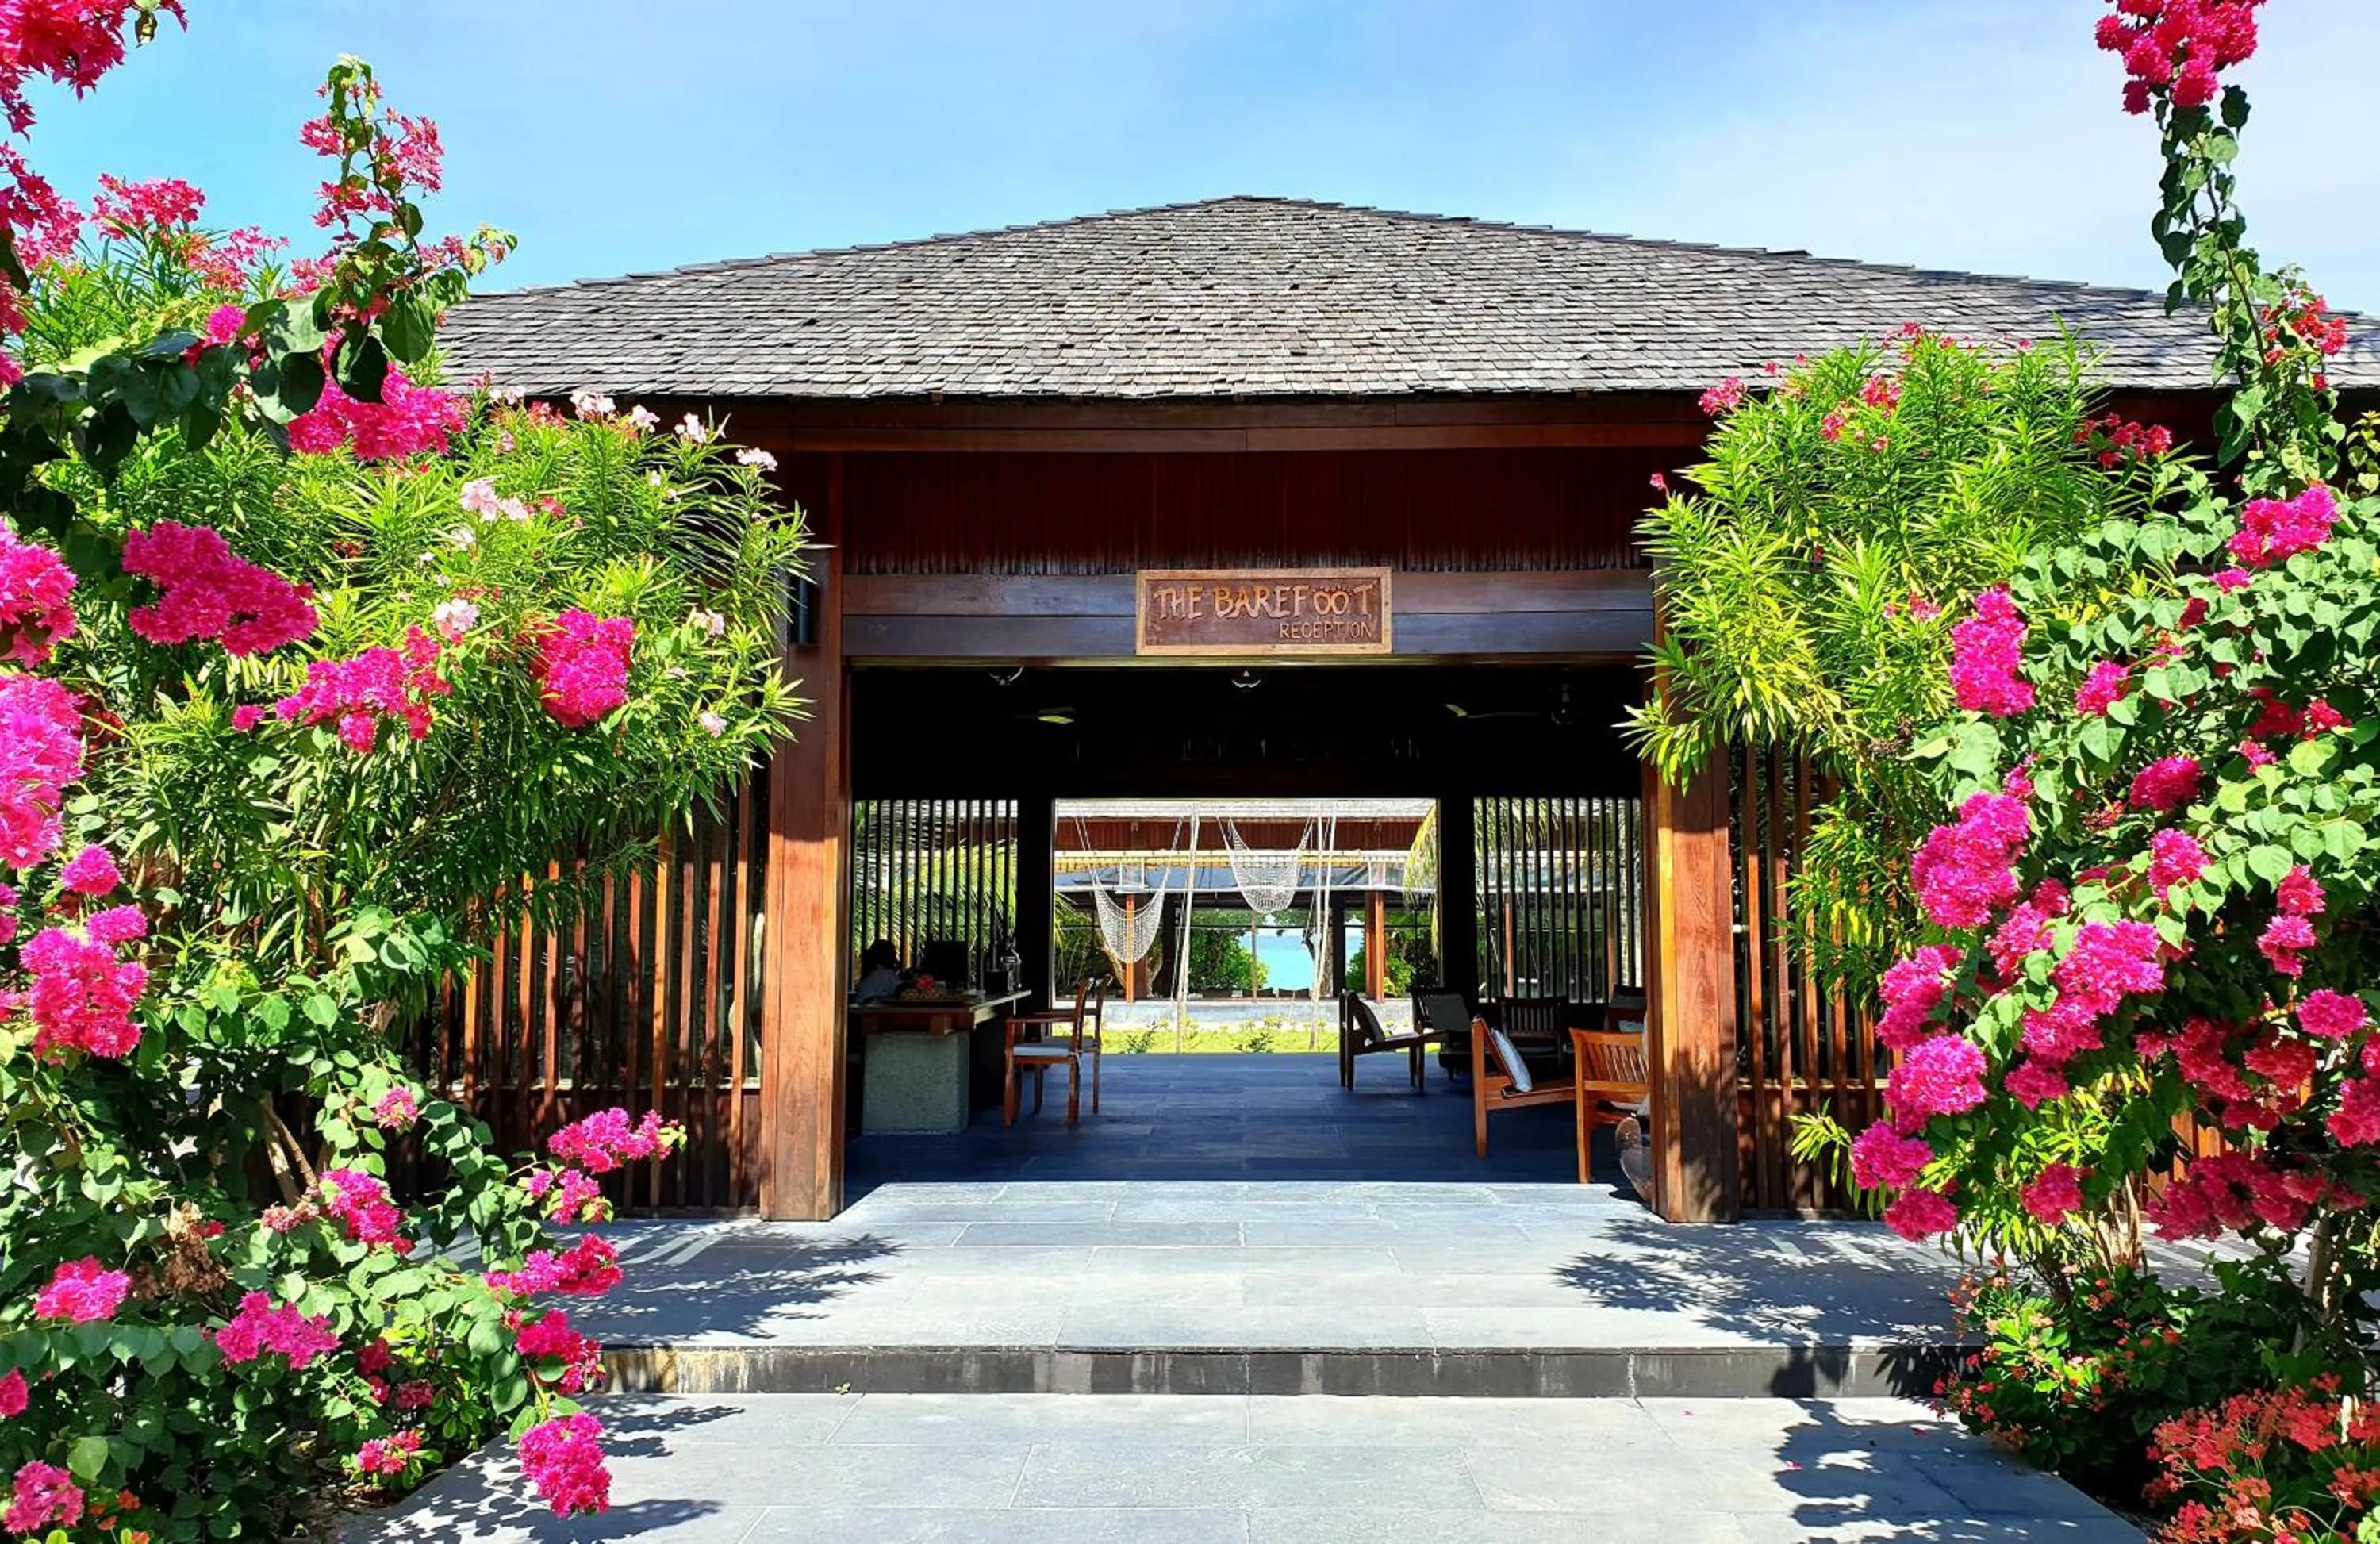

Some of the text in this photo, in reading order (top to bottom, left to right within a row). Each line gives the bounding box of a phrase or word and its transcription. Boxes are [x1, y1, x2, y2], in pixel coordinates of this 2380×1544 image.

[1153, 584, 1373, 619] THE BAREFOOT
[1279, 620, 1372, 639] RECEPTION
